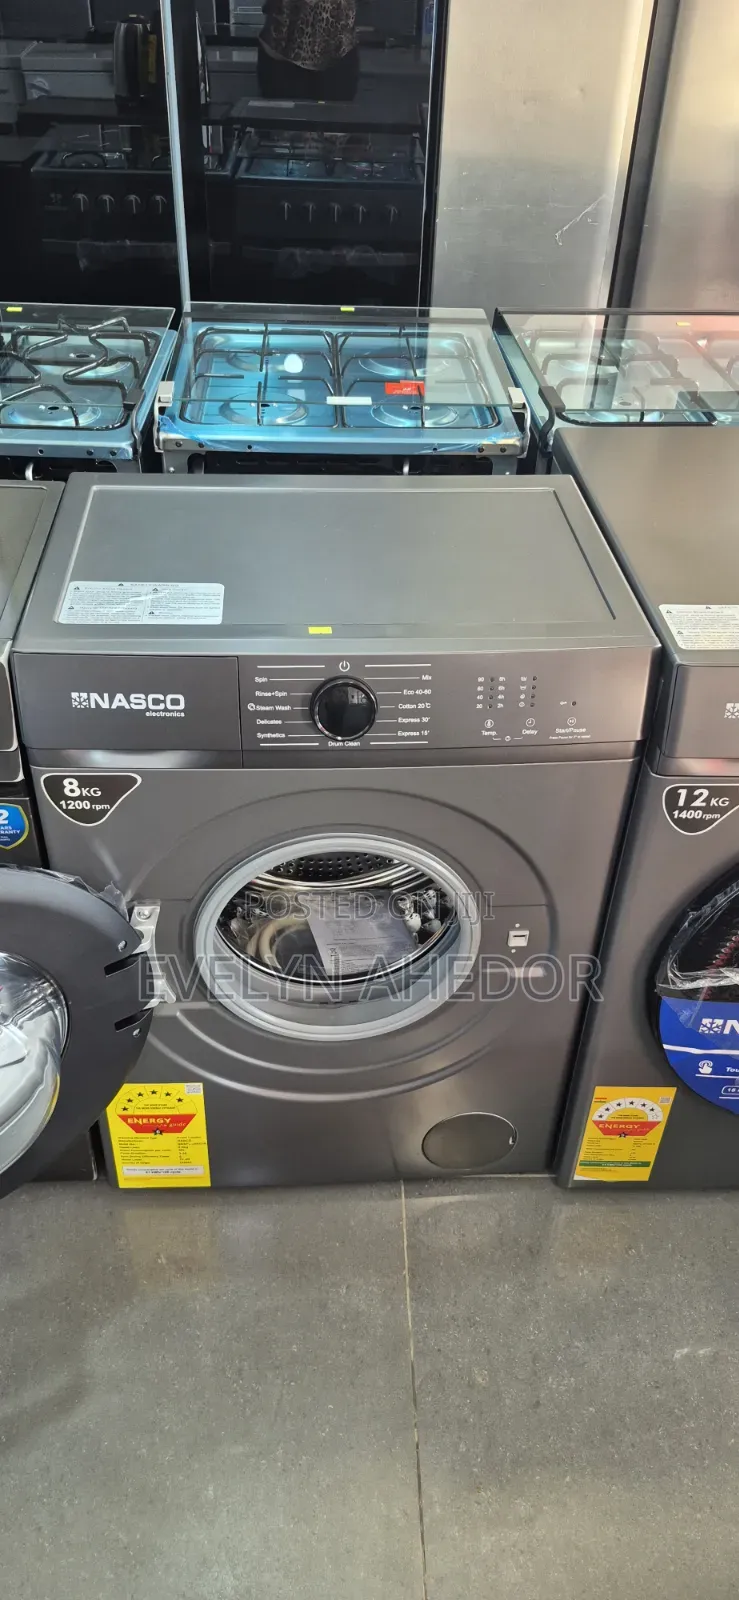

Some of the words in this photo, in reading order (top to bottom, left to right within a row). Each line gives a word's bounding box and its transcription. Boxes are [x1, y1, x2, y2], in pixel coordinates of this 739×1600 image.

[255, 690, 288, 698] Rinse+Spin
[89, 692, 185, 710] NASCO
[521, 728, 539, 736] Delay
[676, 787, 710, 807] 12
[710, 797, 730, 807] KG
[59, 800, 91, 810] 1200
[91, 802, 111, 811] rpm
[127, 1117, 172, 1125] ENERGY
